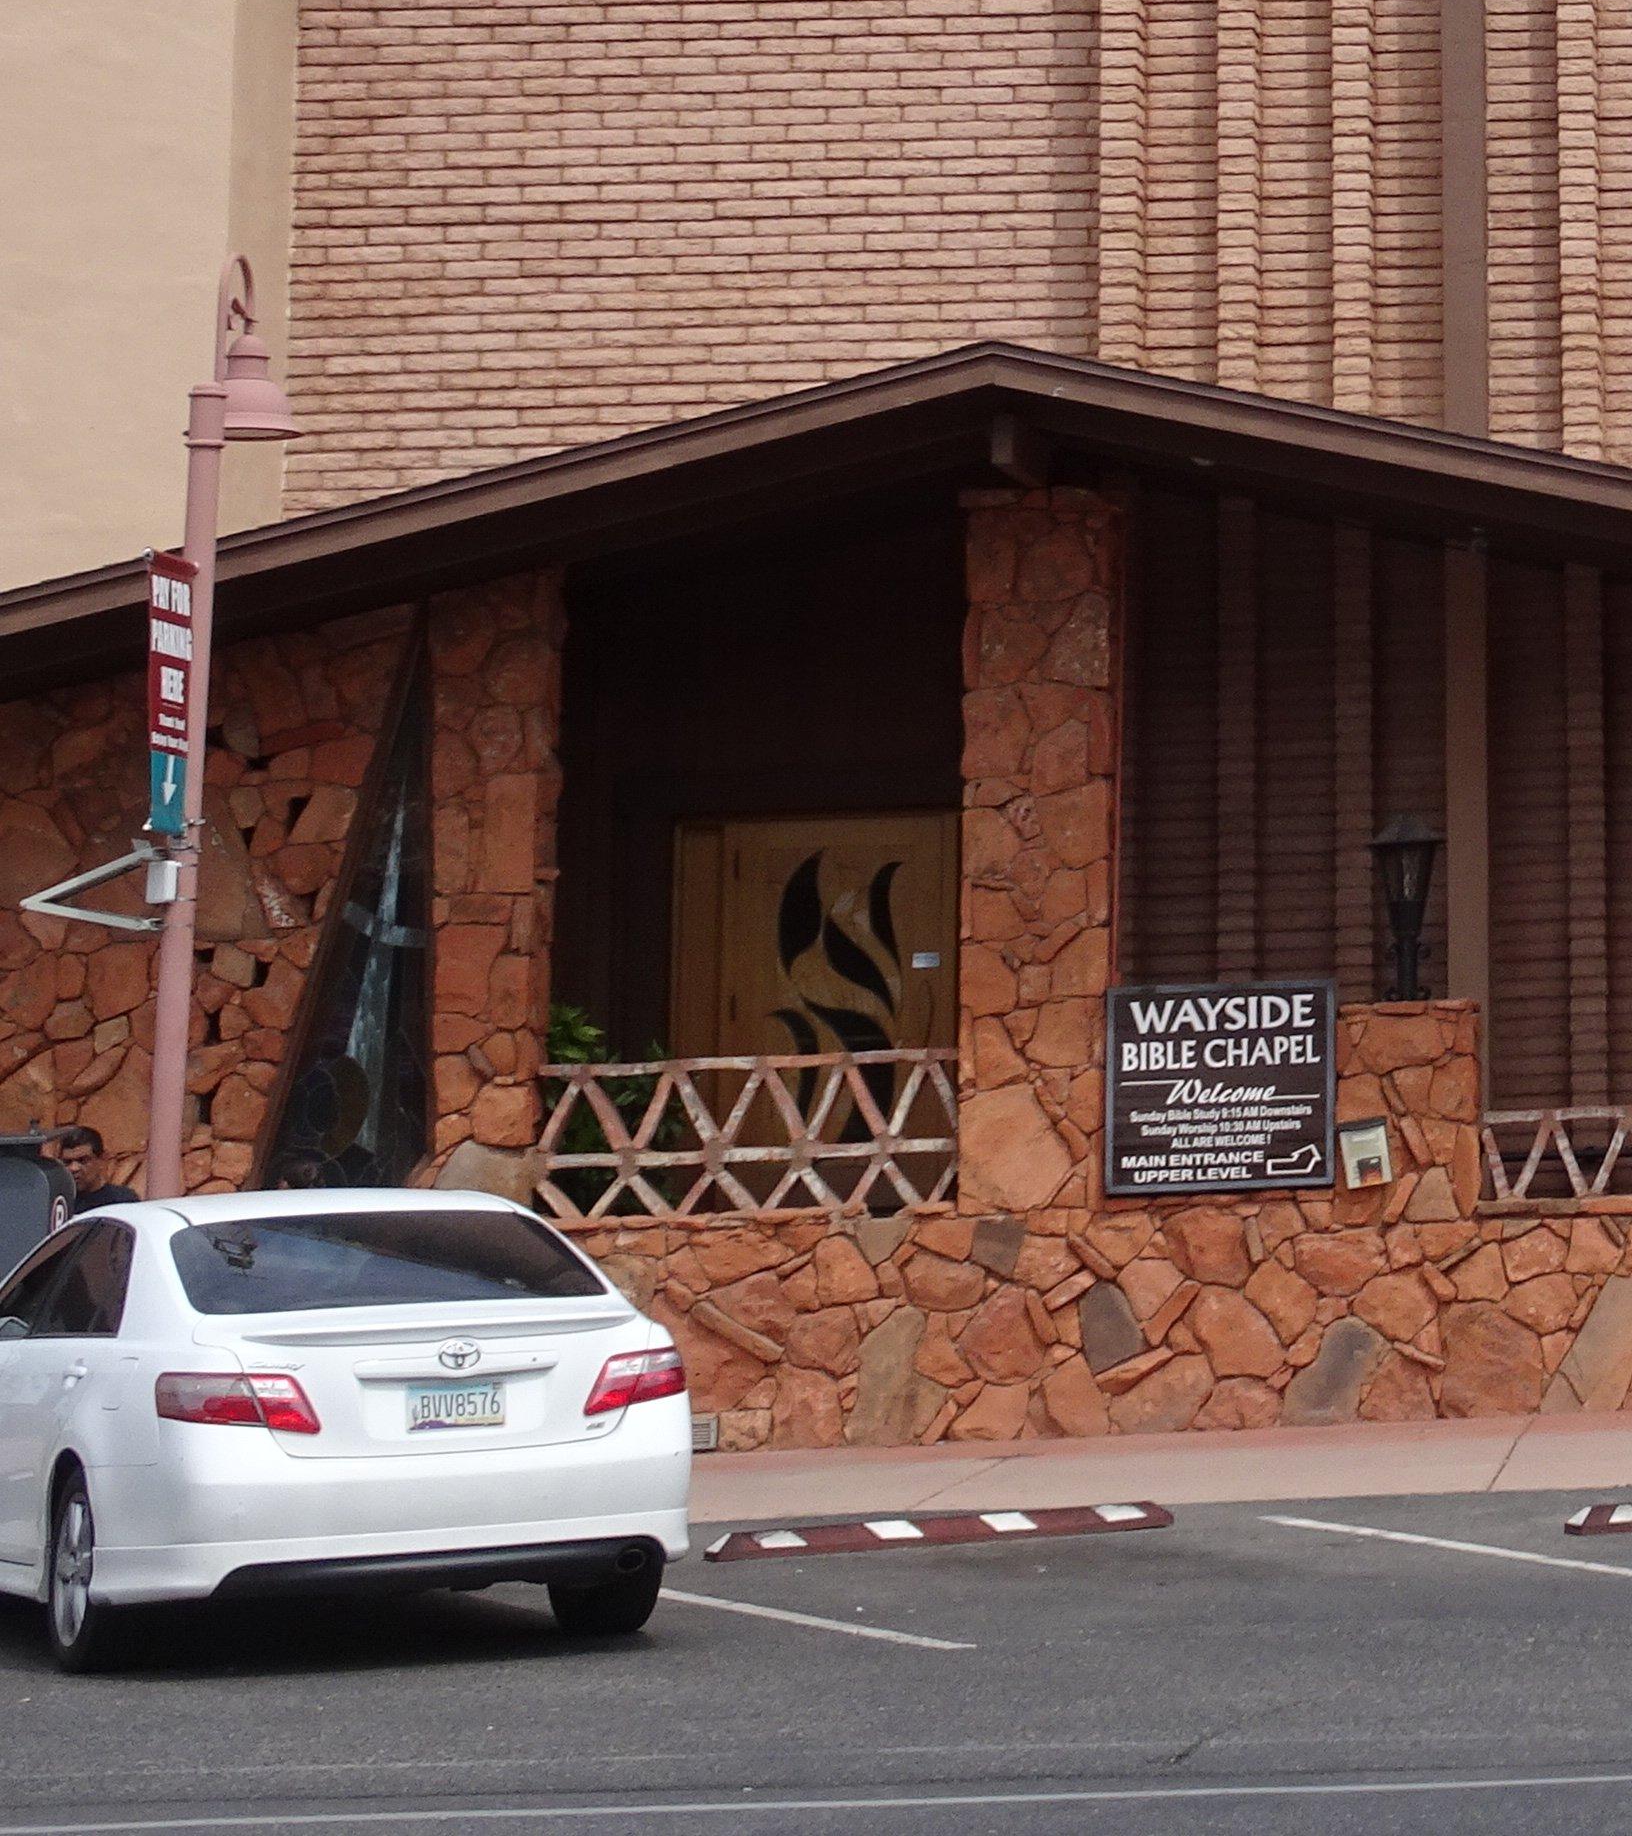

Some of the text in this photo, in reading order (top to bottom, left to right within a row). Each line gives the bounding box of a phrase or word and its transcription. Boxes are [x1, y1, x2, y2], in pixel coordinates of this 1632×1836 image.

[1129, 993, 1317, 1035] WAYSIDE
[1121, 1034, 1321, 1072] BIBLE CHAPEL
[1165, 1079, 1276, 1105] Welcome
[1129, 1110, 1166, 1124] Sunday
[1167, 1109, 1192, 1121] Bible
[1193, 1108, 1220, 1121] Study
[1243, 1106, 1259, 1117] AM
[1260, 1104, 1312, 1116] Downstairs
[1141, 1124, 1177, 1137] Sunday
[1178, 1122, 1218, 1135] Worship
[1245, 1121, 1261, 1131] AM
[1262, 1119, 1301, 1132] Upstairs
[1171, 1137, 1192, 1149] ALL
[1193, 1136, 1214, 1148] ARE
[1121, 1150, 1264, 1169] MAIN ENTRANCE
[1133, 1166, 1252, 1184] UPPER LEVEL
[420, 1391, 500, 1419] BVV8576
